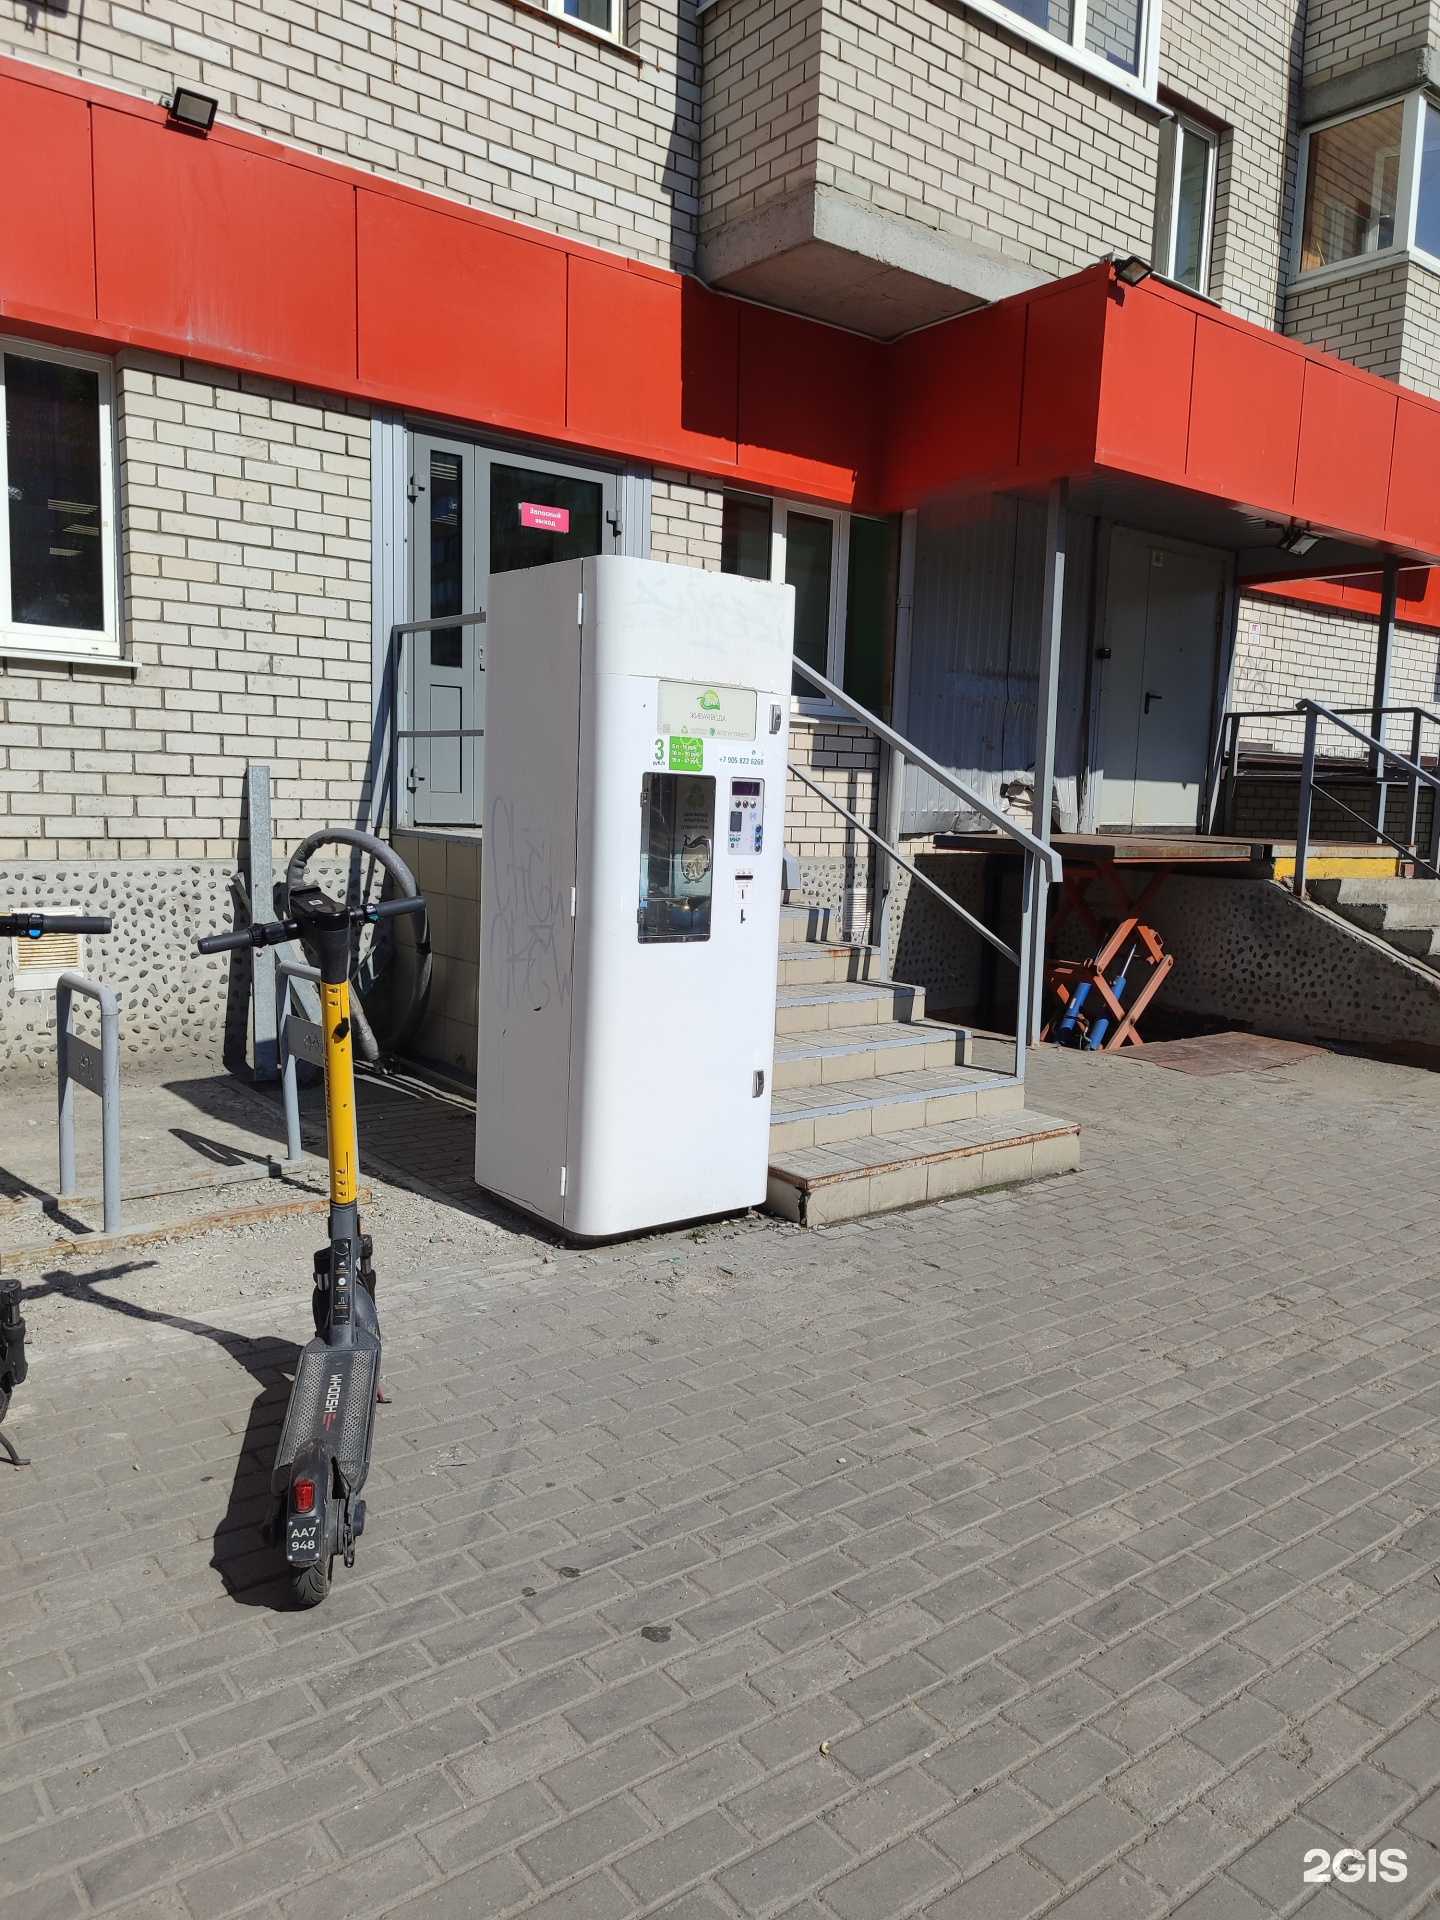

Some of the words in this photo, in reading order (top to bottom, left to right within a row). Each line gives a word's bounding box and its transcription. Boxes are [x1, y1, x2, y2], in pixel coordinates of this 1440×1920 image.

[654, 738, 665, 760] 3
[323, 1373, 343, 1413] WHOOSH
[291, 1527, 316, 1538] AA7
[291, 1540, 315, 1551] 948
